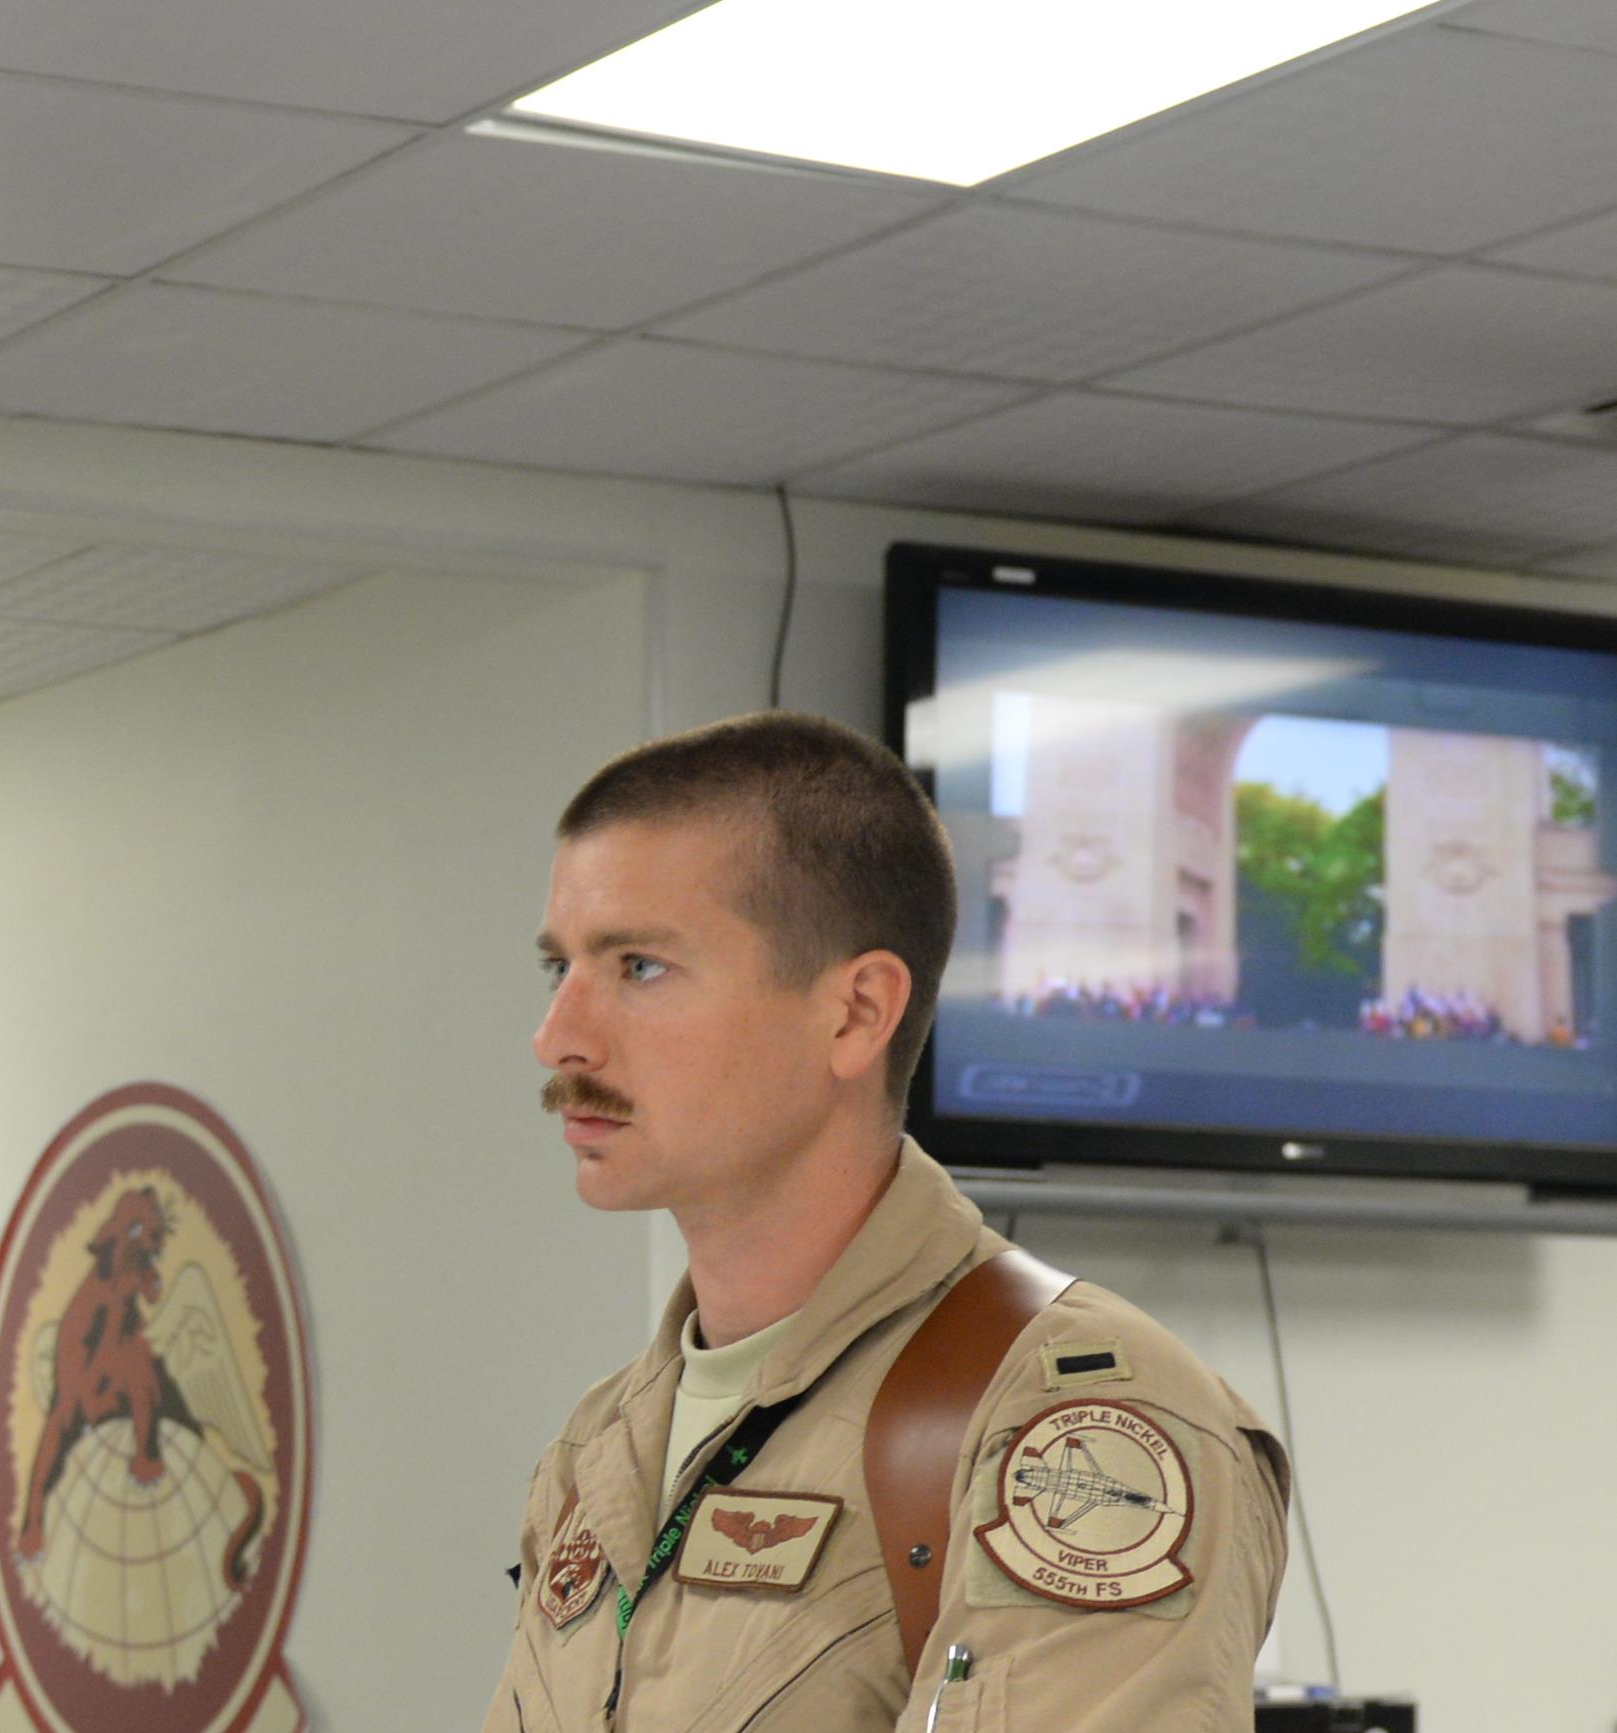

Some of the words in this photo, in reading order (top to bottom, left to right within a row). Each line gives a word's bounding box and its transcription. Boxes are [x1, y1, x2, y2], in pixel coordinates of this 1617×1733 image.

[1049, 1410, 1112, 1431] TRIPLE
[1115, 1411, 1169, 1461] NICKEL
[702, 1559, 740, 1578] ALEX
[1057, 1549, 1109, 1572] VIPER
[1031, 1566, 1089, 1596] 555TH
[1095, 1581, 1123, 1598] FS
